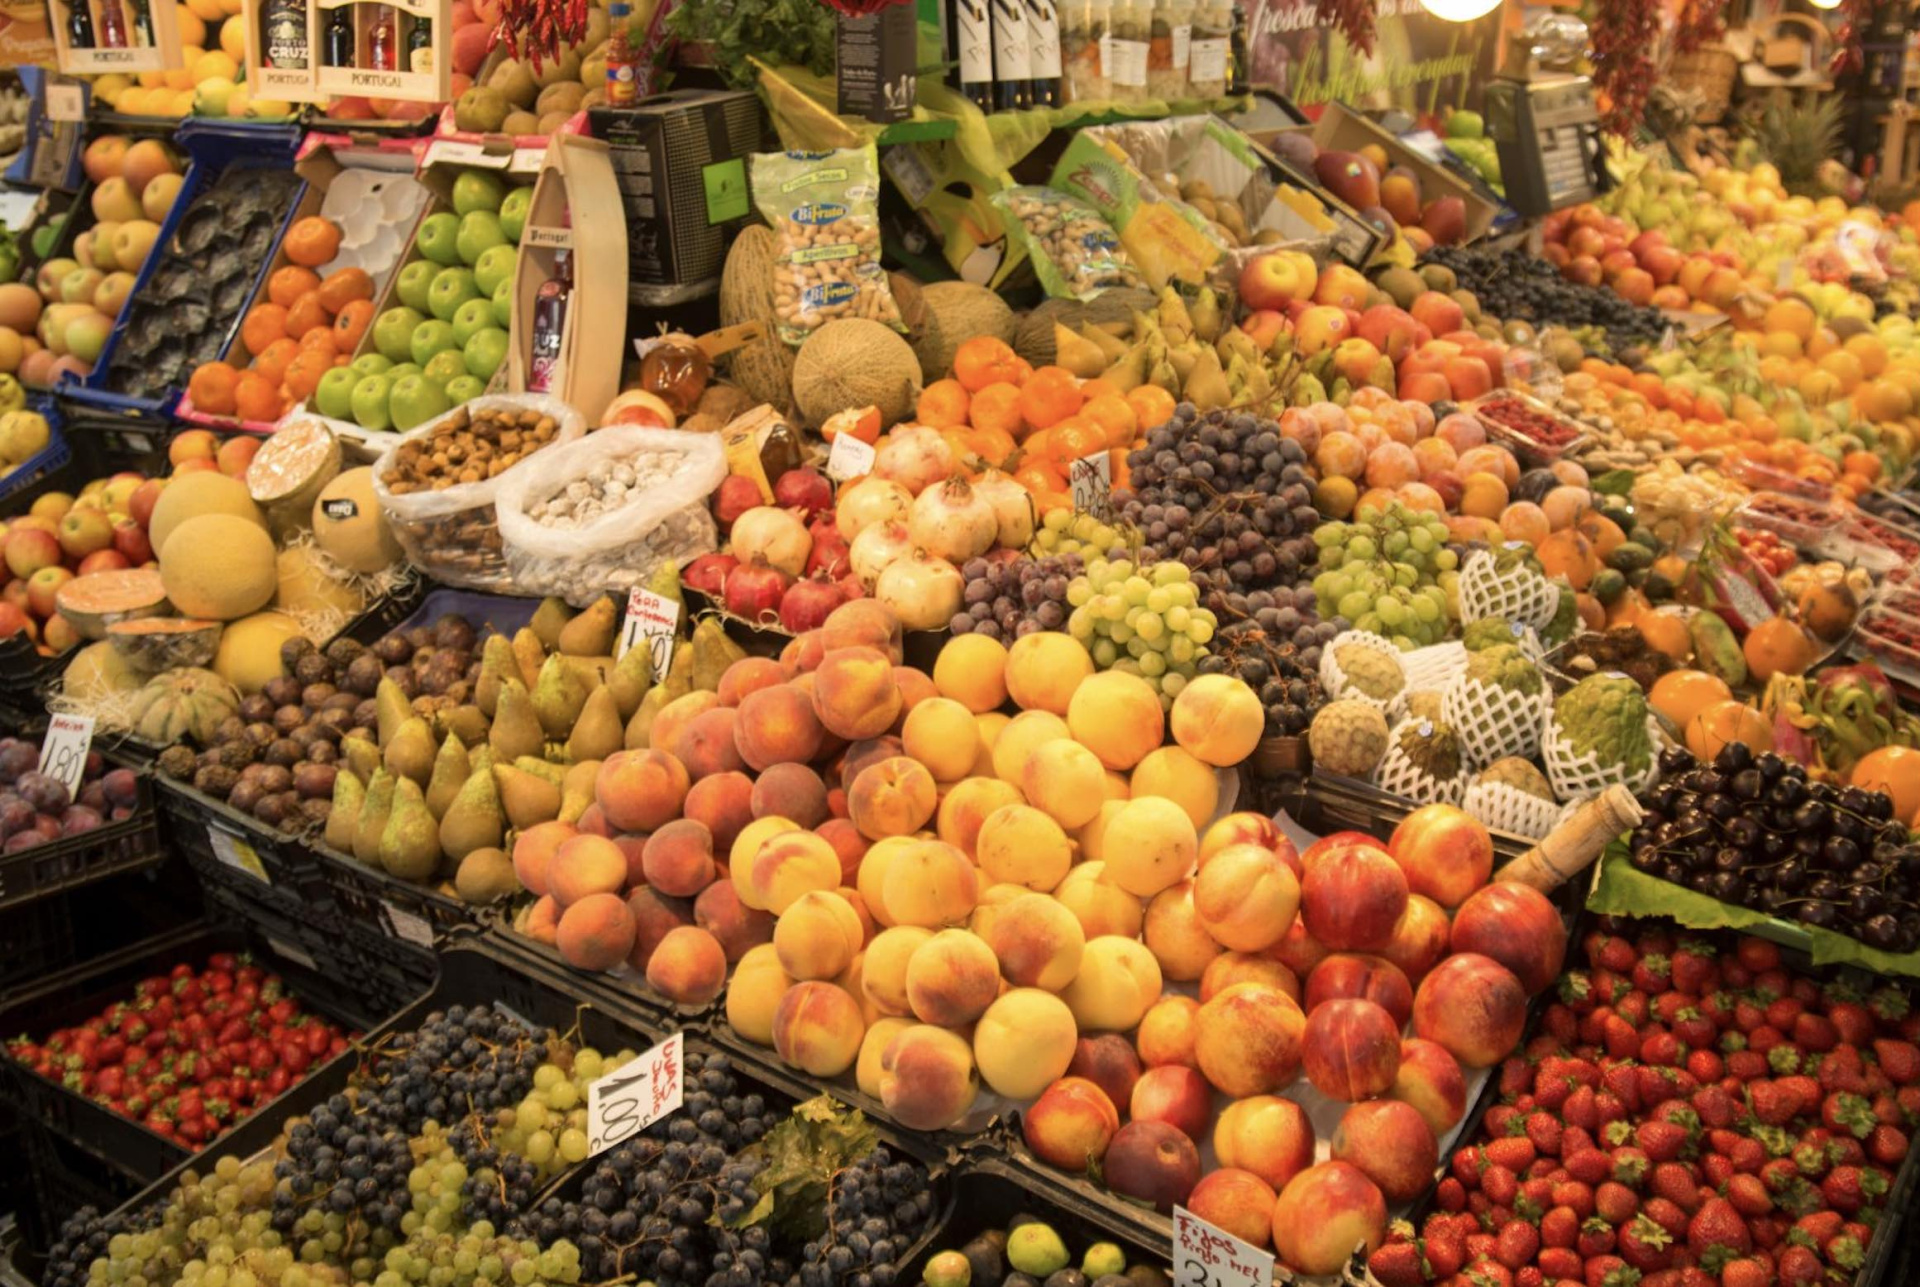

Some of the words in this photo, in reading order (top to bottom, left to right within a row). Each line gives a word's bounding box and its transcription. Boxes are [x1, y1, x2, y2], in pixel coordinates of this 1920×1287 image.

[268, 47, 308, 59] CRUZ
[267, 74, 309, 84] PORTUGA
[351, 73, 402, 88] PORTUGAL
[531, 230, 568, 243] Portugal
